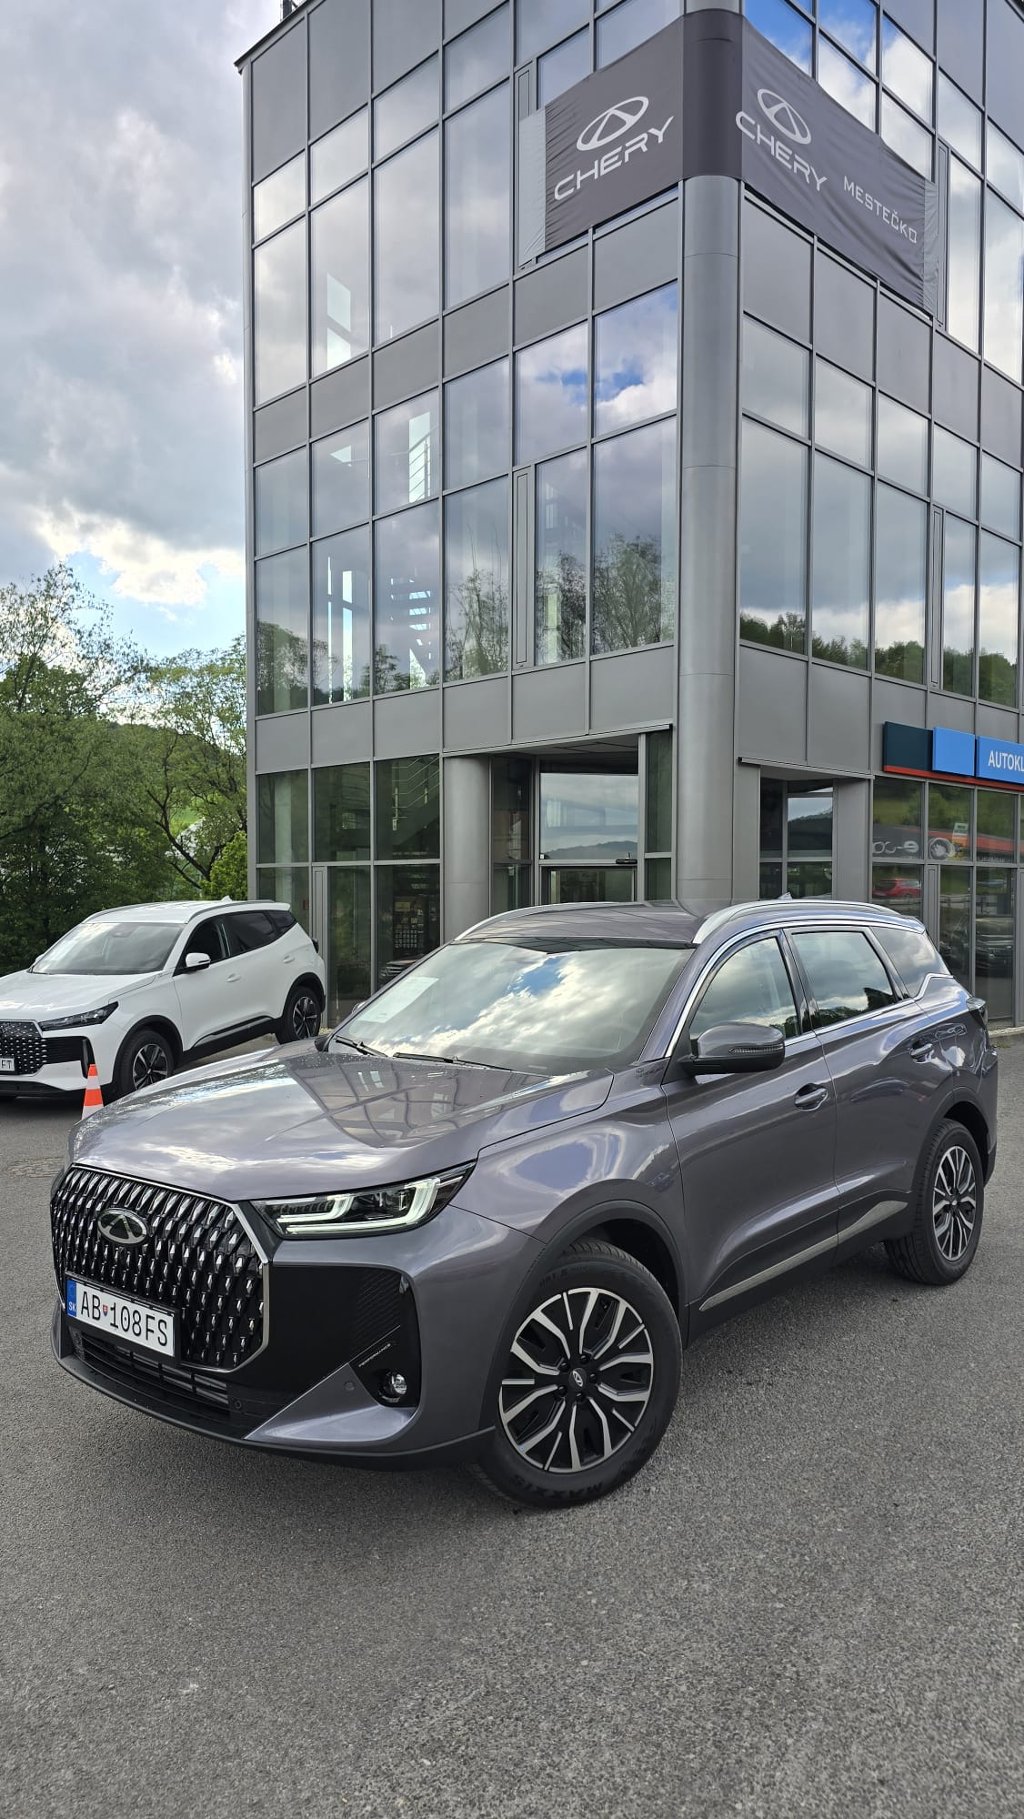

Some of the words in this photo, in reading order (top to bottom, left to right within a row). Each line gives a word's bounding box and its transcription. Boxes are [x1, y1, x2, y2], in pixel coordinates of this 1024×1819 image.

[554, 115, 674, 201] CHERY
[735, 110, 828, 192] CHERY
[843, 175, 918, 244] MESTEČKO
